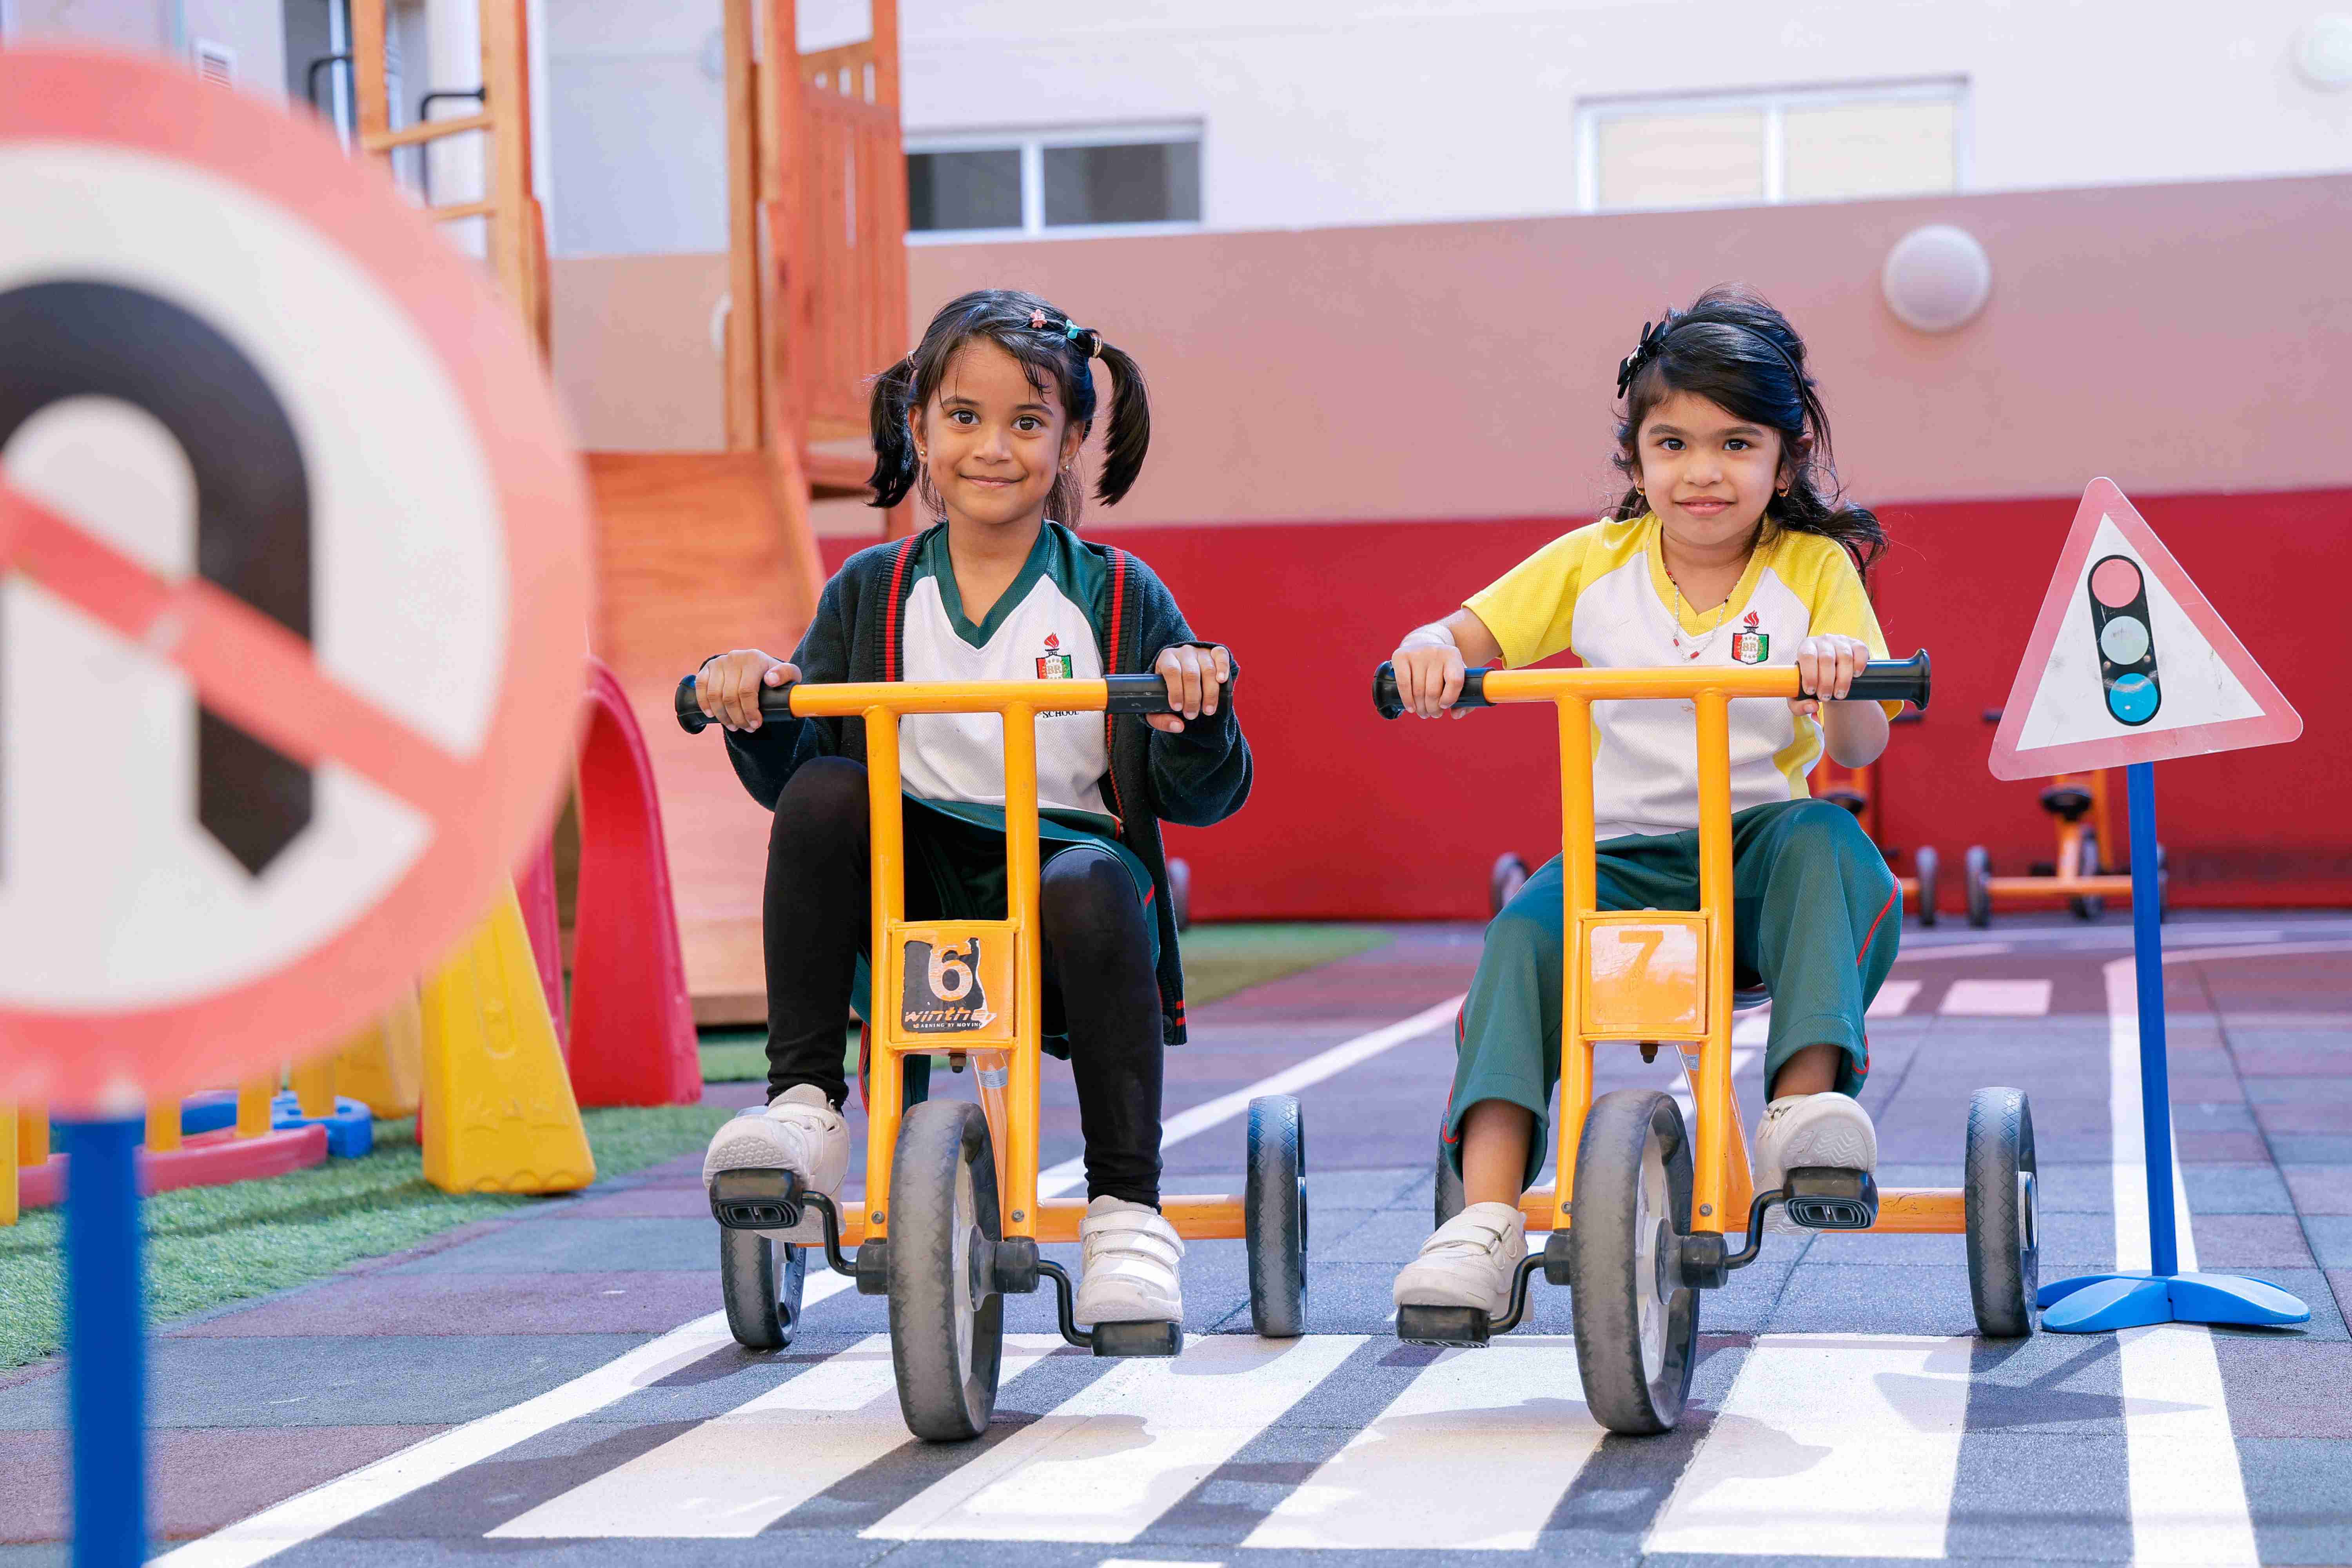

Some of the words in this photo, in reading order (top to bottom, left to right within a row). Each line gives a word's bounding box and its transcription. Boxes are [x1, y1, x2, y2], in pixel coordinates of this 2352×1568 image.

[928, 944, 973, 1001] 6
[1619, 930, 1664, 989] 7
[904, 1007, 997, 1022] winthe
